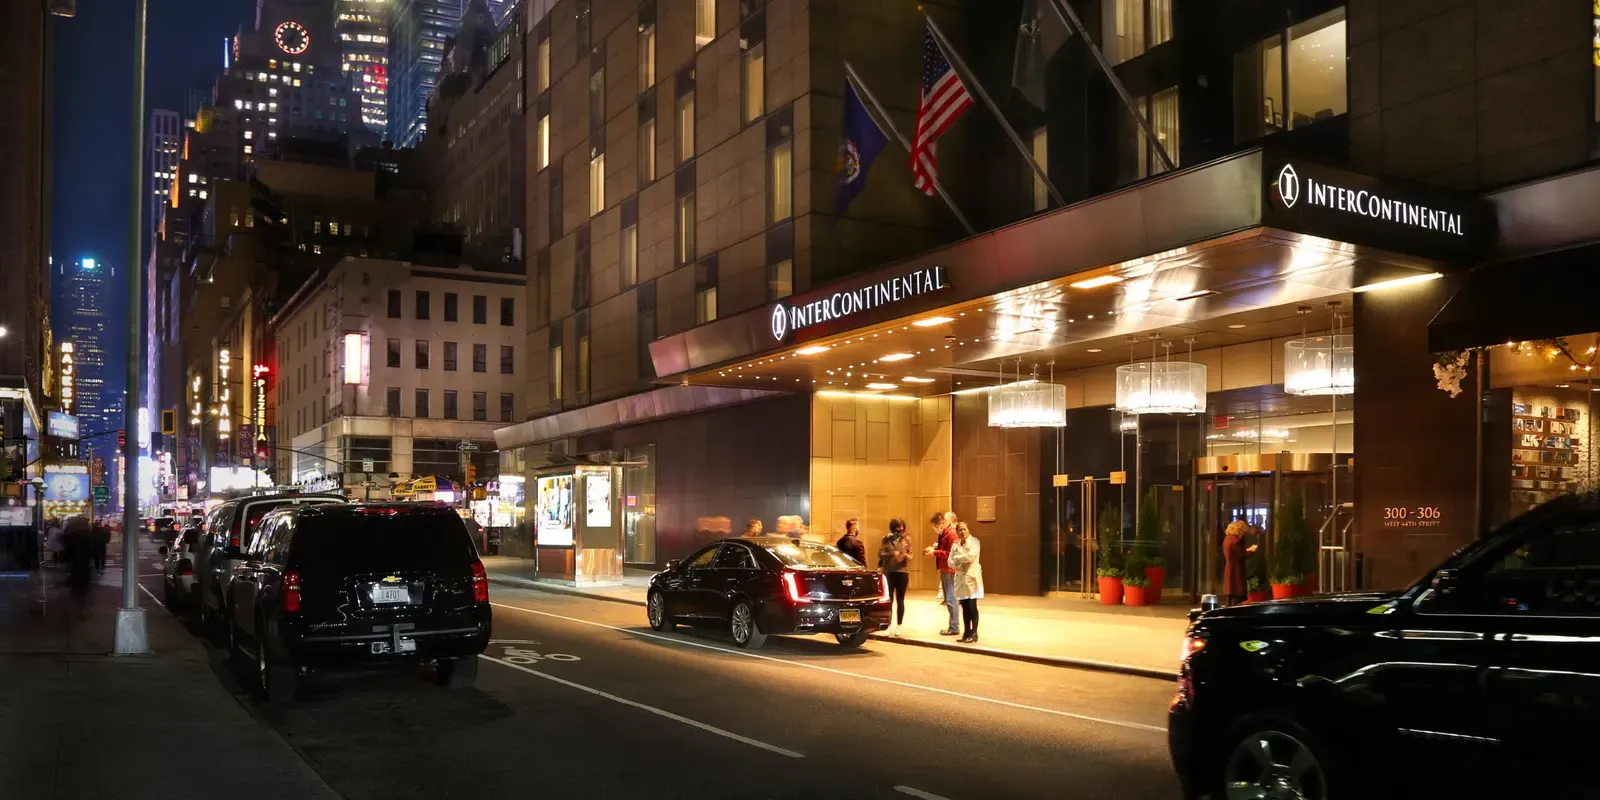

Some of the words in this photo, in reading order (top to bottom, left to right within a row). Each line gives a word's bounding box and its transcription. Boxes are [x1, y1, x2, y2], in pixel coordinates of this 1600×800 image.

[1308, 178, 1464, 236] INTERCONTINENTAL
[790, 266, 943, 330] INTERCONTINENTAL
[257, 379, 267, 441] PIZZERIA
